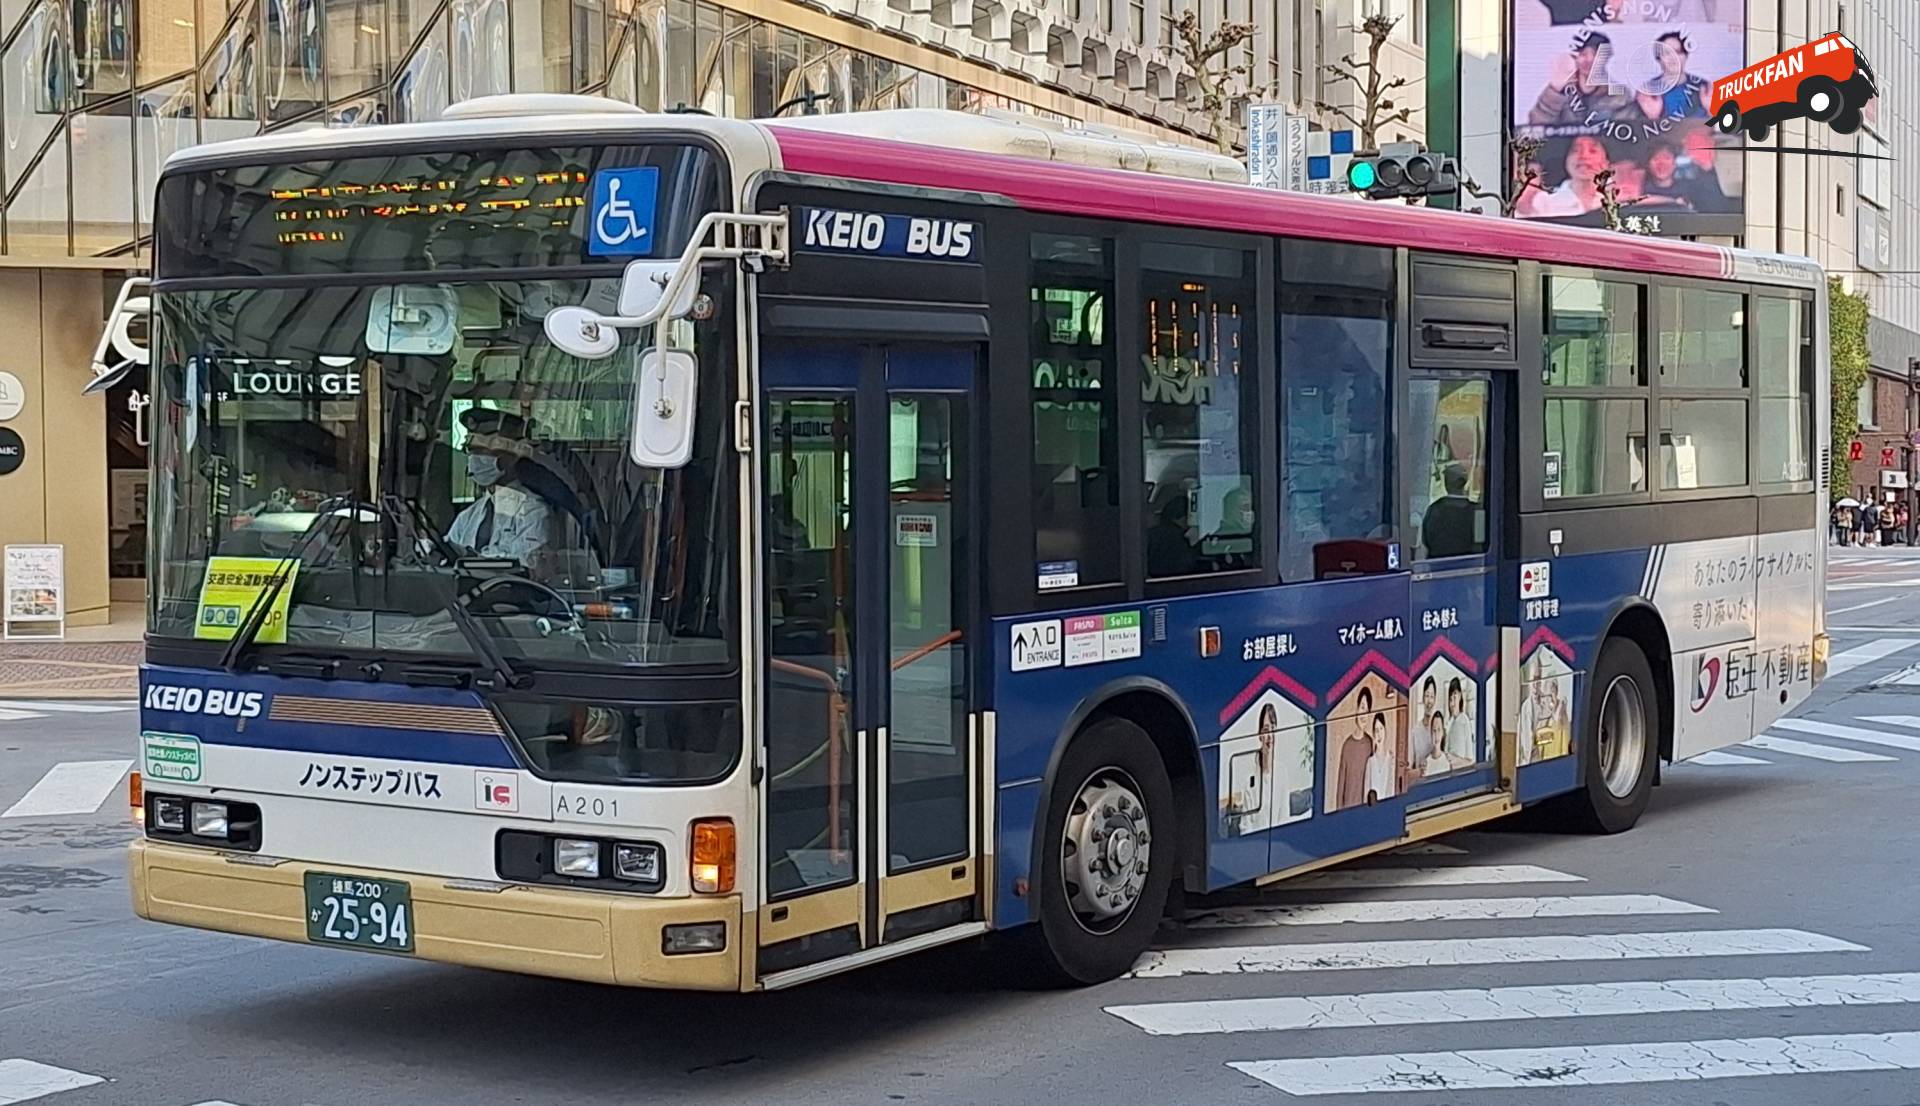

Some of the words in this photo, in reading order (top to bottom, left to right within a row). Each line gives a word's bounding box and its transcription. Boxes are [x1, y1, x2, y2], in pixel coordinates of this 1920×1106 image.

[1567, 2, 1616, 59] MEN'S
[1642, 104, 1686, 139] New
[1251, 108, 1263, 176] Inokashiradori
[805, 209, 885, 250] KEIO
[906, 217, 973, 257] BUS
[1694, 551, 1813, 587] あなたのライフサイクルに
[1338, 618, 1404, 645] マイホーム購入
[1422, 607, 1459, 631] 住み替え
[1031, 626, 1056, 648] 入口
[1243, 633, 1297, 661] お部屋探し
[1027, 648, 1060, 664] ENTRANCE
[1726, 642, 1810, 694] 京王不動産
[144, 684, 203, 713] KEIO
[203, 689, 263, 718] BUS
[299, 763, 441, 799] ノンステップバス
[557, 795, 617, 817] A201
[323, 896, 407, 946] 25-94
